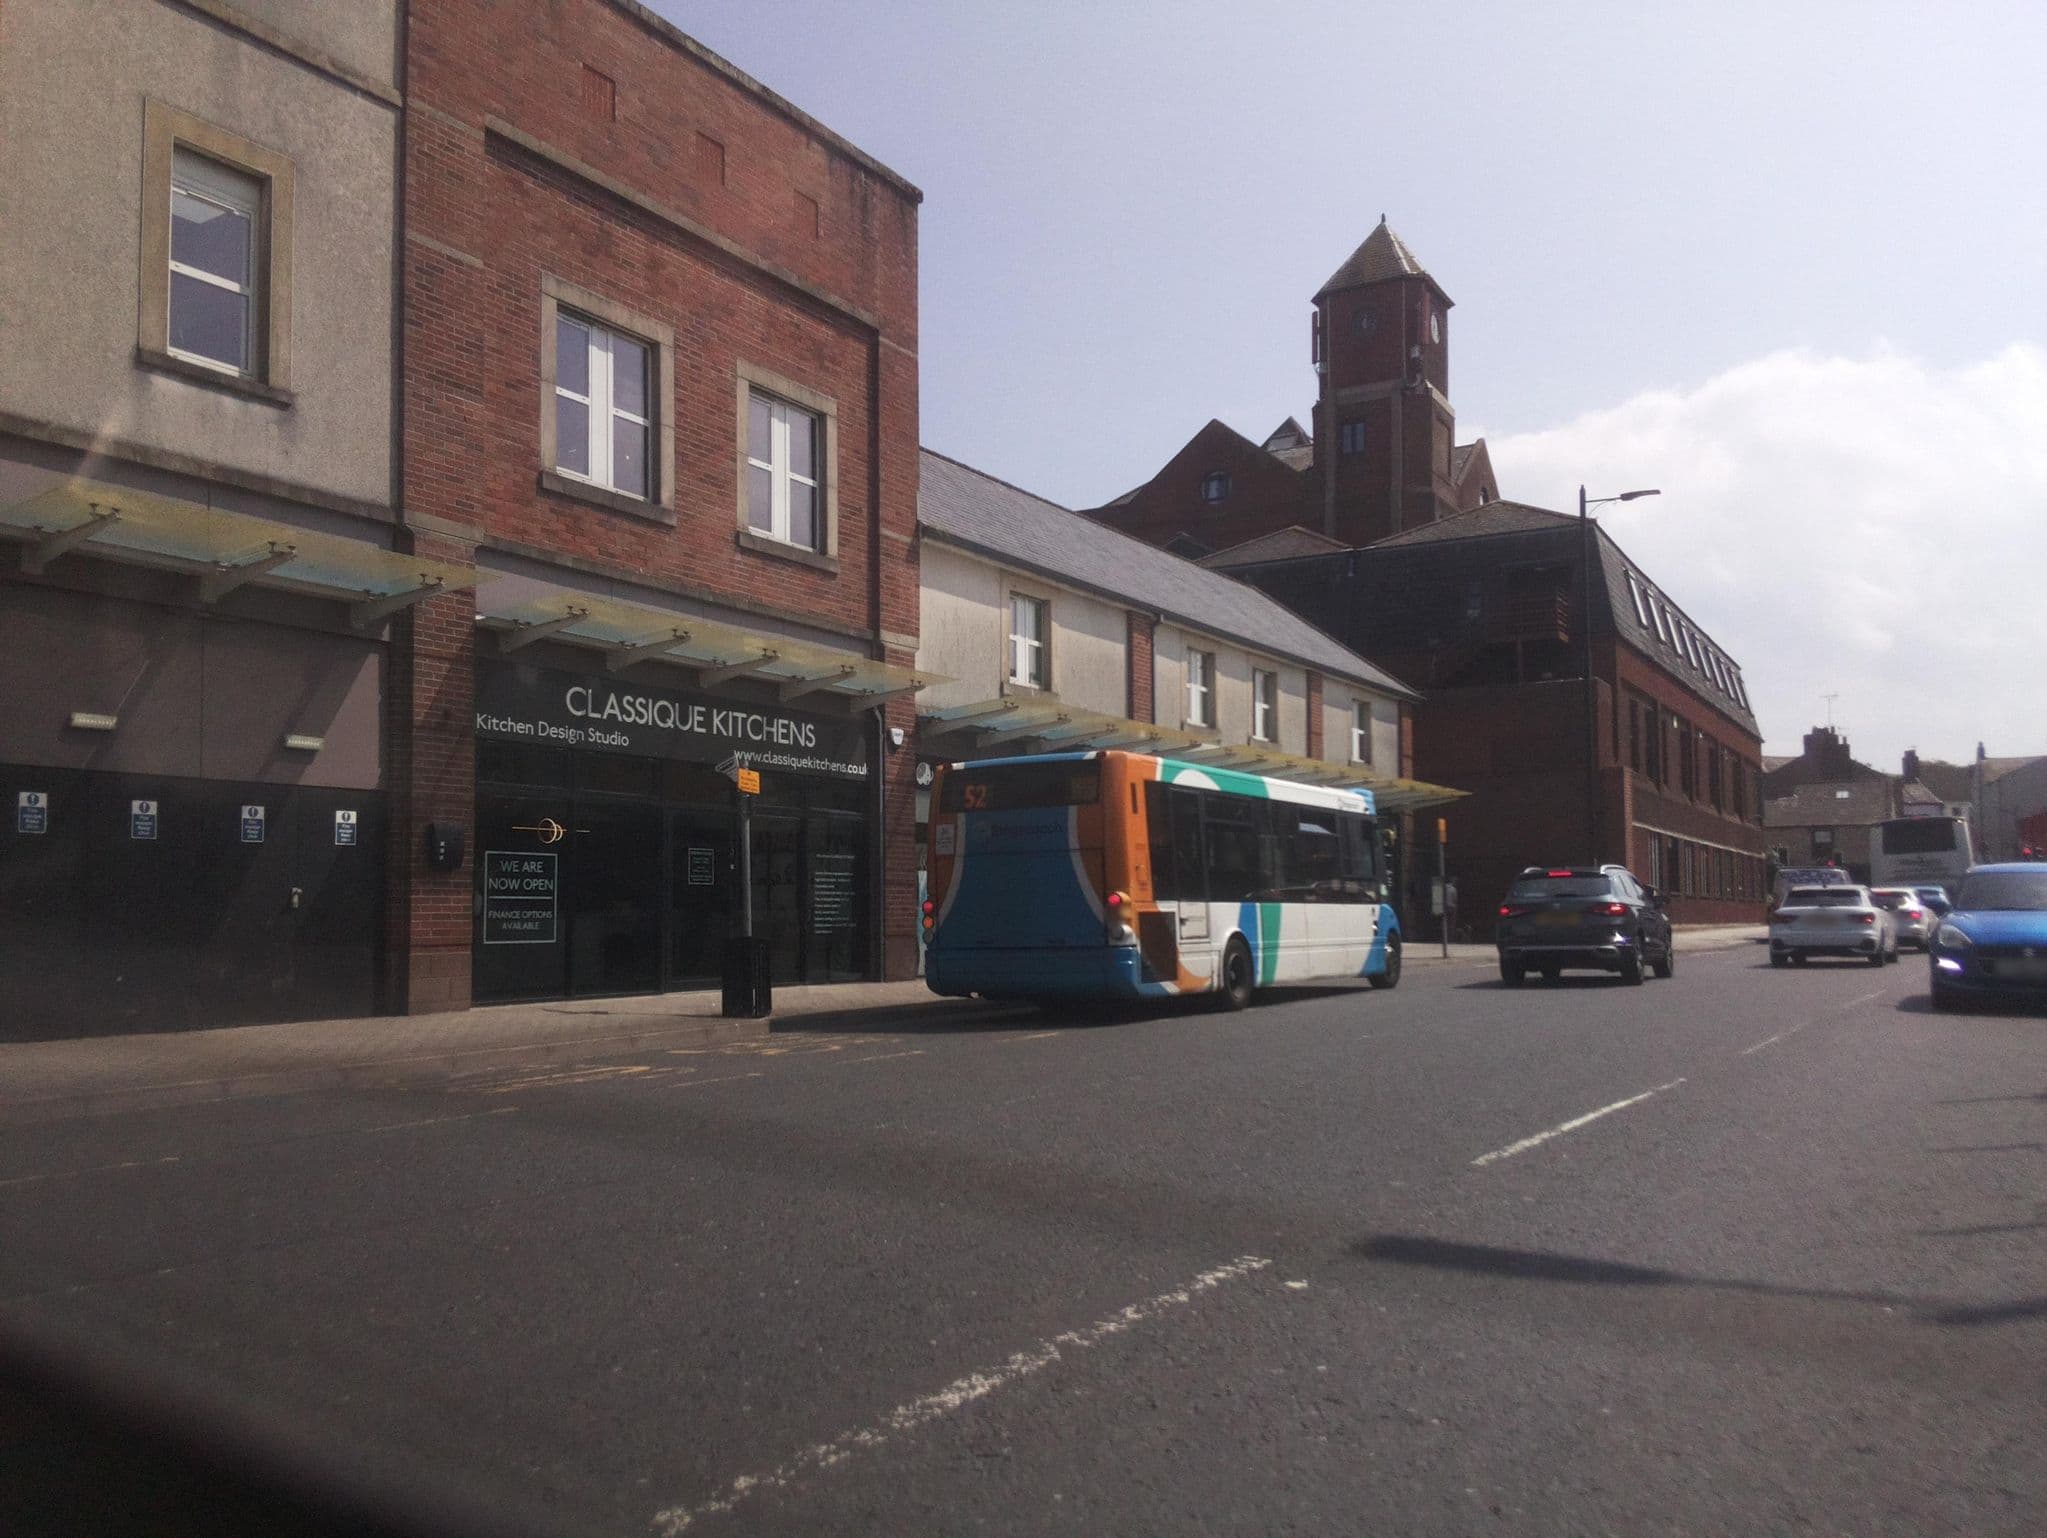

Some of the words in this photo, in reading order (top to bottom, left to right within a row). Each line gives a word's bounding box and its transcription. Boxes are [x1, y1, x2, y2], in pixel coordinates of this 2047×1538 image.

[566, 687, 706, 733] CLASSIQUE
[712, 709, 816, 748] KITCHENS
[476, 713, 534, 735] Kitchen
[538, 721, 584, 744] Design
[588, 727, 630, 747] Studio
[964, 783, 987, 809] 52
[501, 860, 520, 873] WE
[522, 861, 544, 873] ARE
[489, 878, 520, 890] NOW
[523, 879, 554, 891] OPEN
[488, 910, 521, 919] FINANCE
[522, 910, 553, 919] OPTIONS
[502, 921, 540, 930] AVAILABLE
